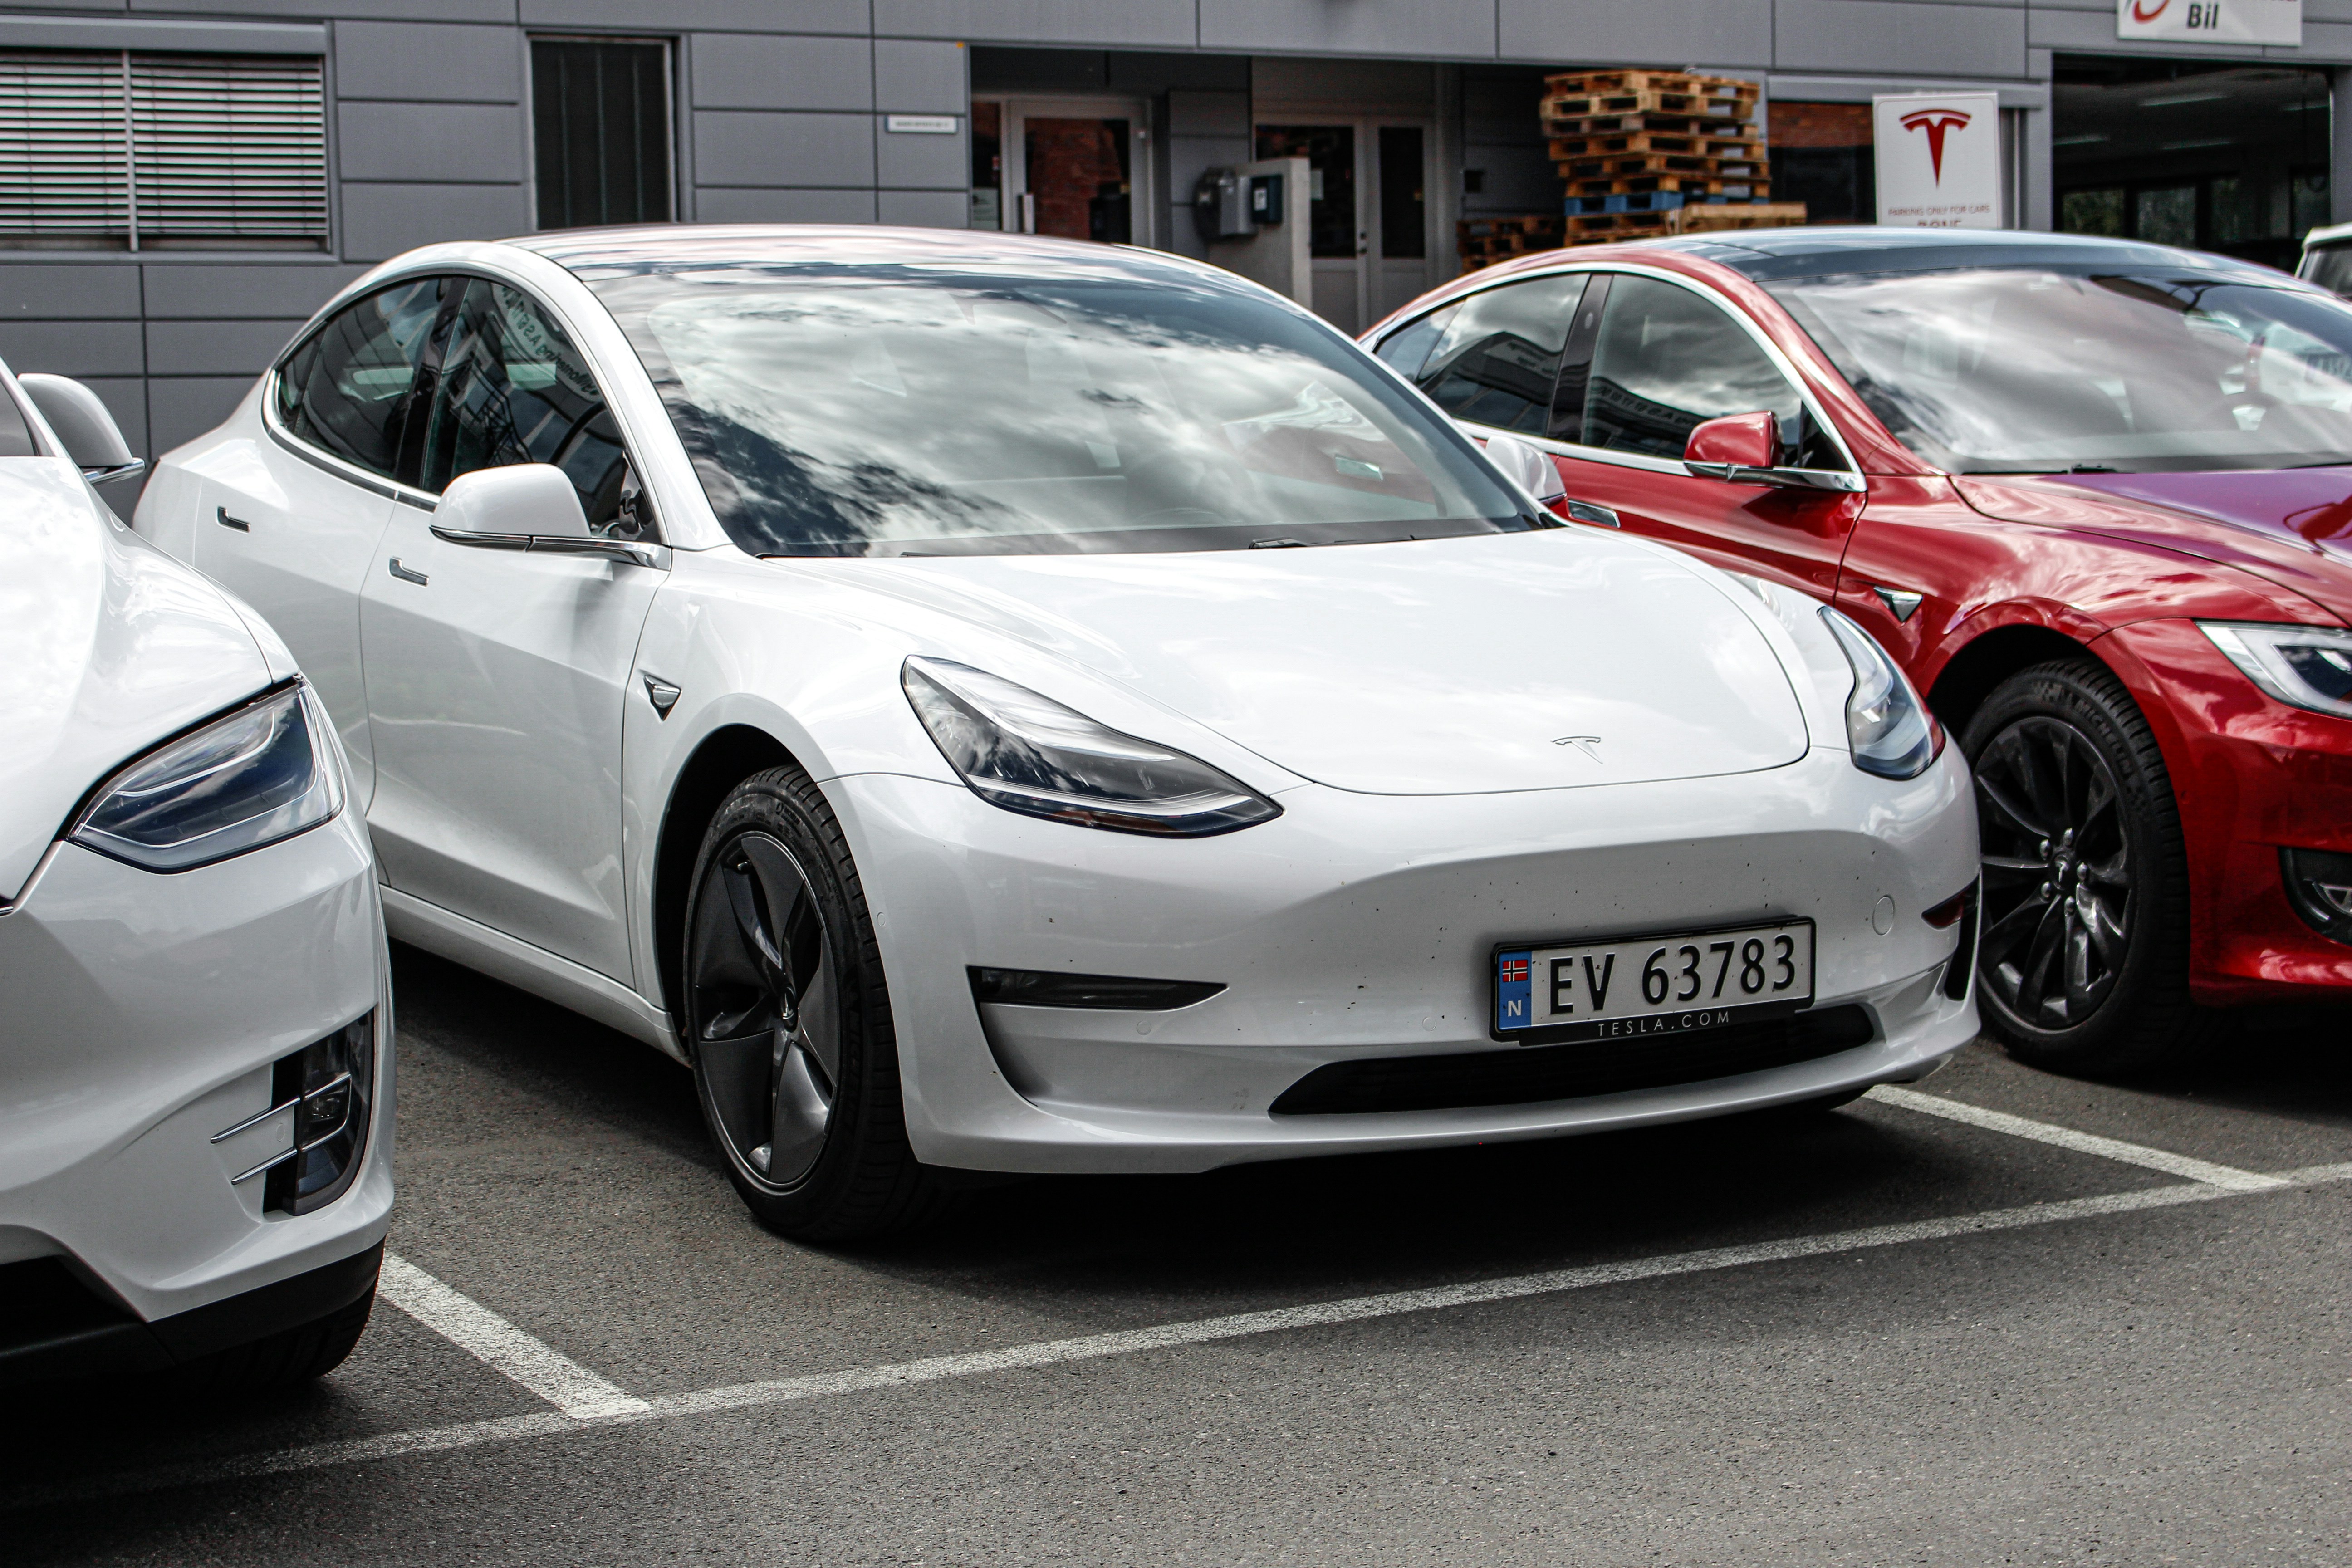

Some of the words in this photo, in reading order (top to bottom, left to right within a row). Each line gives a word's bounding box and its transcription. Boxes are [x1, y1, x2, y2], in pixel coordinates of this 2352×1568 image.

[2187, 3, 2220, 29] Bil
[2074, 697, 2134, 779] MICHELIN
[1549, 954, 1615, 1015] EV
[1642, 935, 1795, 1005] 63783
[1507, 1000, 1522, 1017] N
[1598, 1011, 1730, 1037] TESLA.COM
